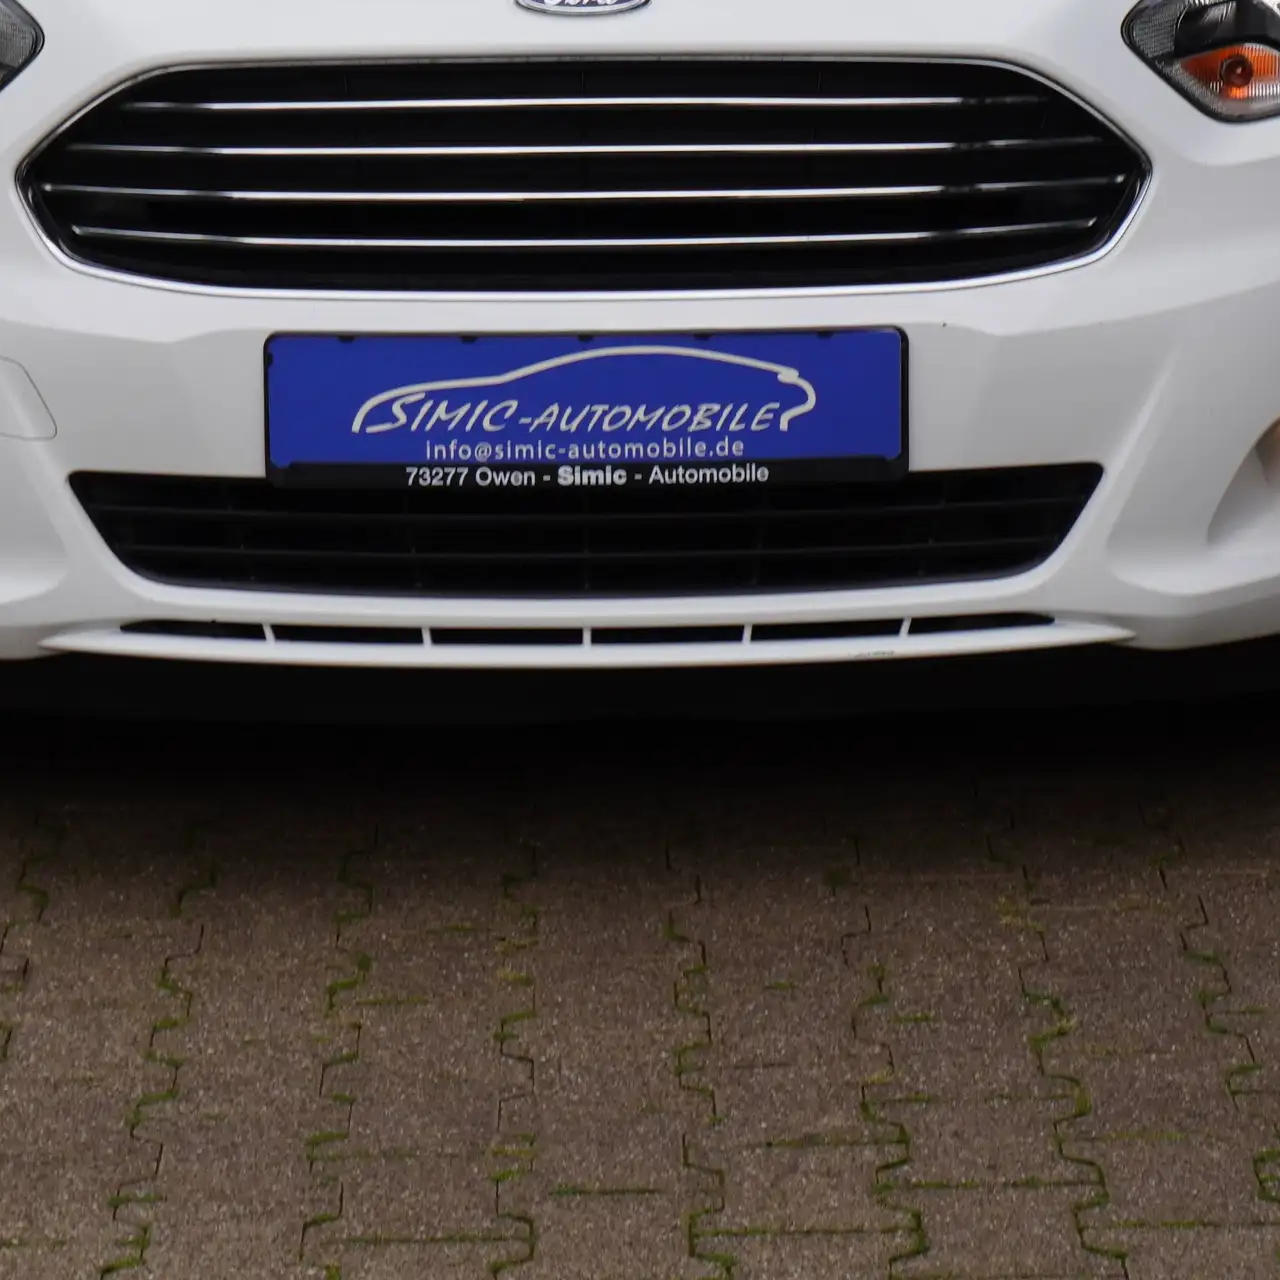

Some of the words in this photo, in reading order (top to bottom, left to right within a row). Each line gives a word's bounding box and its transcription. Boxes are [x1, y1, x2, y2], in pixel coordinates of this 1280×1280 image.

[365, 392, 781, 434] SIMIC-AUTOMOBILE
[426, 436, 744, 461] info@simic-automobile.de
[406, 467, 469, 487] 73277
[475, 466, 536, 487] Owen
[557, 464, 627, 486] Simic
[648, 462, 770, 485] Automobile
